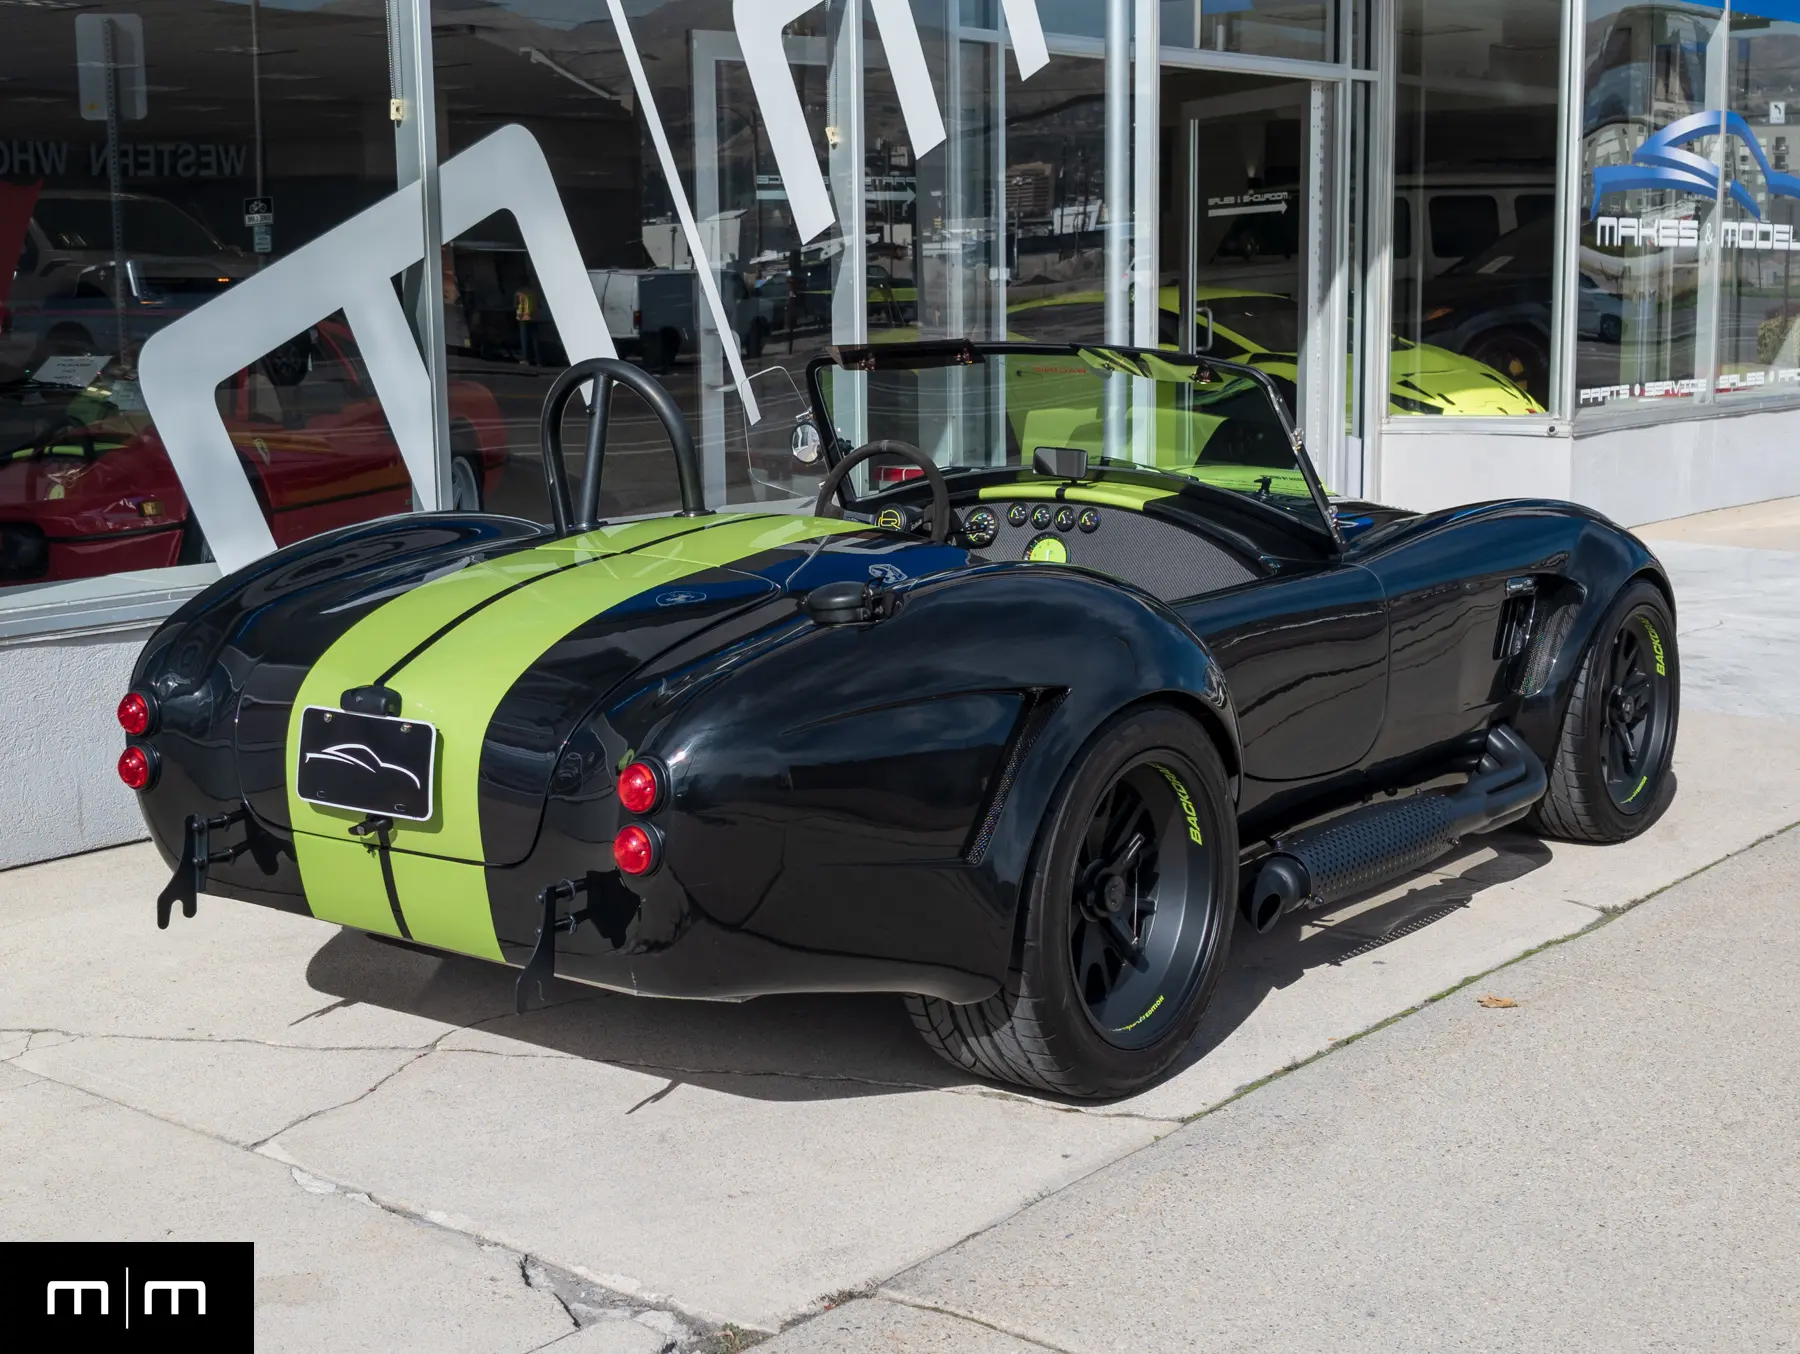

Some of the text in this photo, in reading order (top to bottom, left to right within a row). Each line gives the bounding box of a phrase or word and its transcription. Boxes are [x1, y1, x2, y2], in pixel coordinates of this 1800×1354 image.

[1597, 217, 1699, 248] MAKES
[1704, 222, 1714, 246] &
[1580, 384, 1630, 404] PARTS
[1644, 378, 1707, 398] SERVICE
[1719, 371, 1765, 389] SALES
